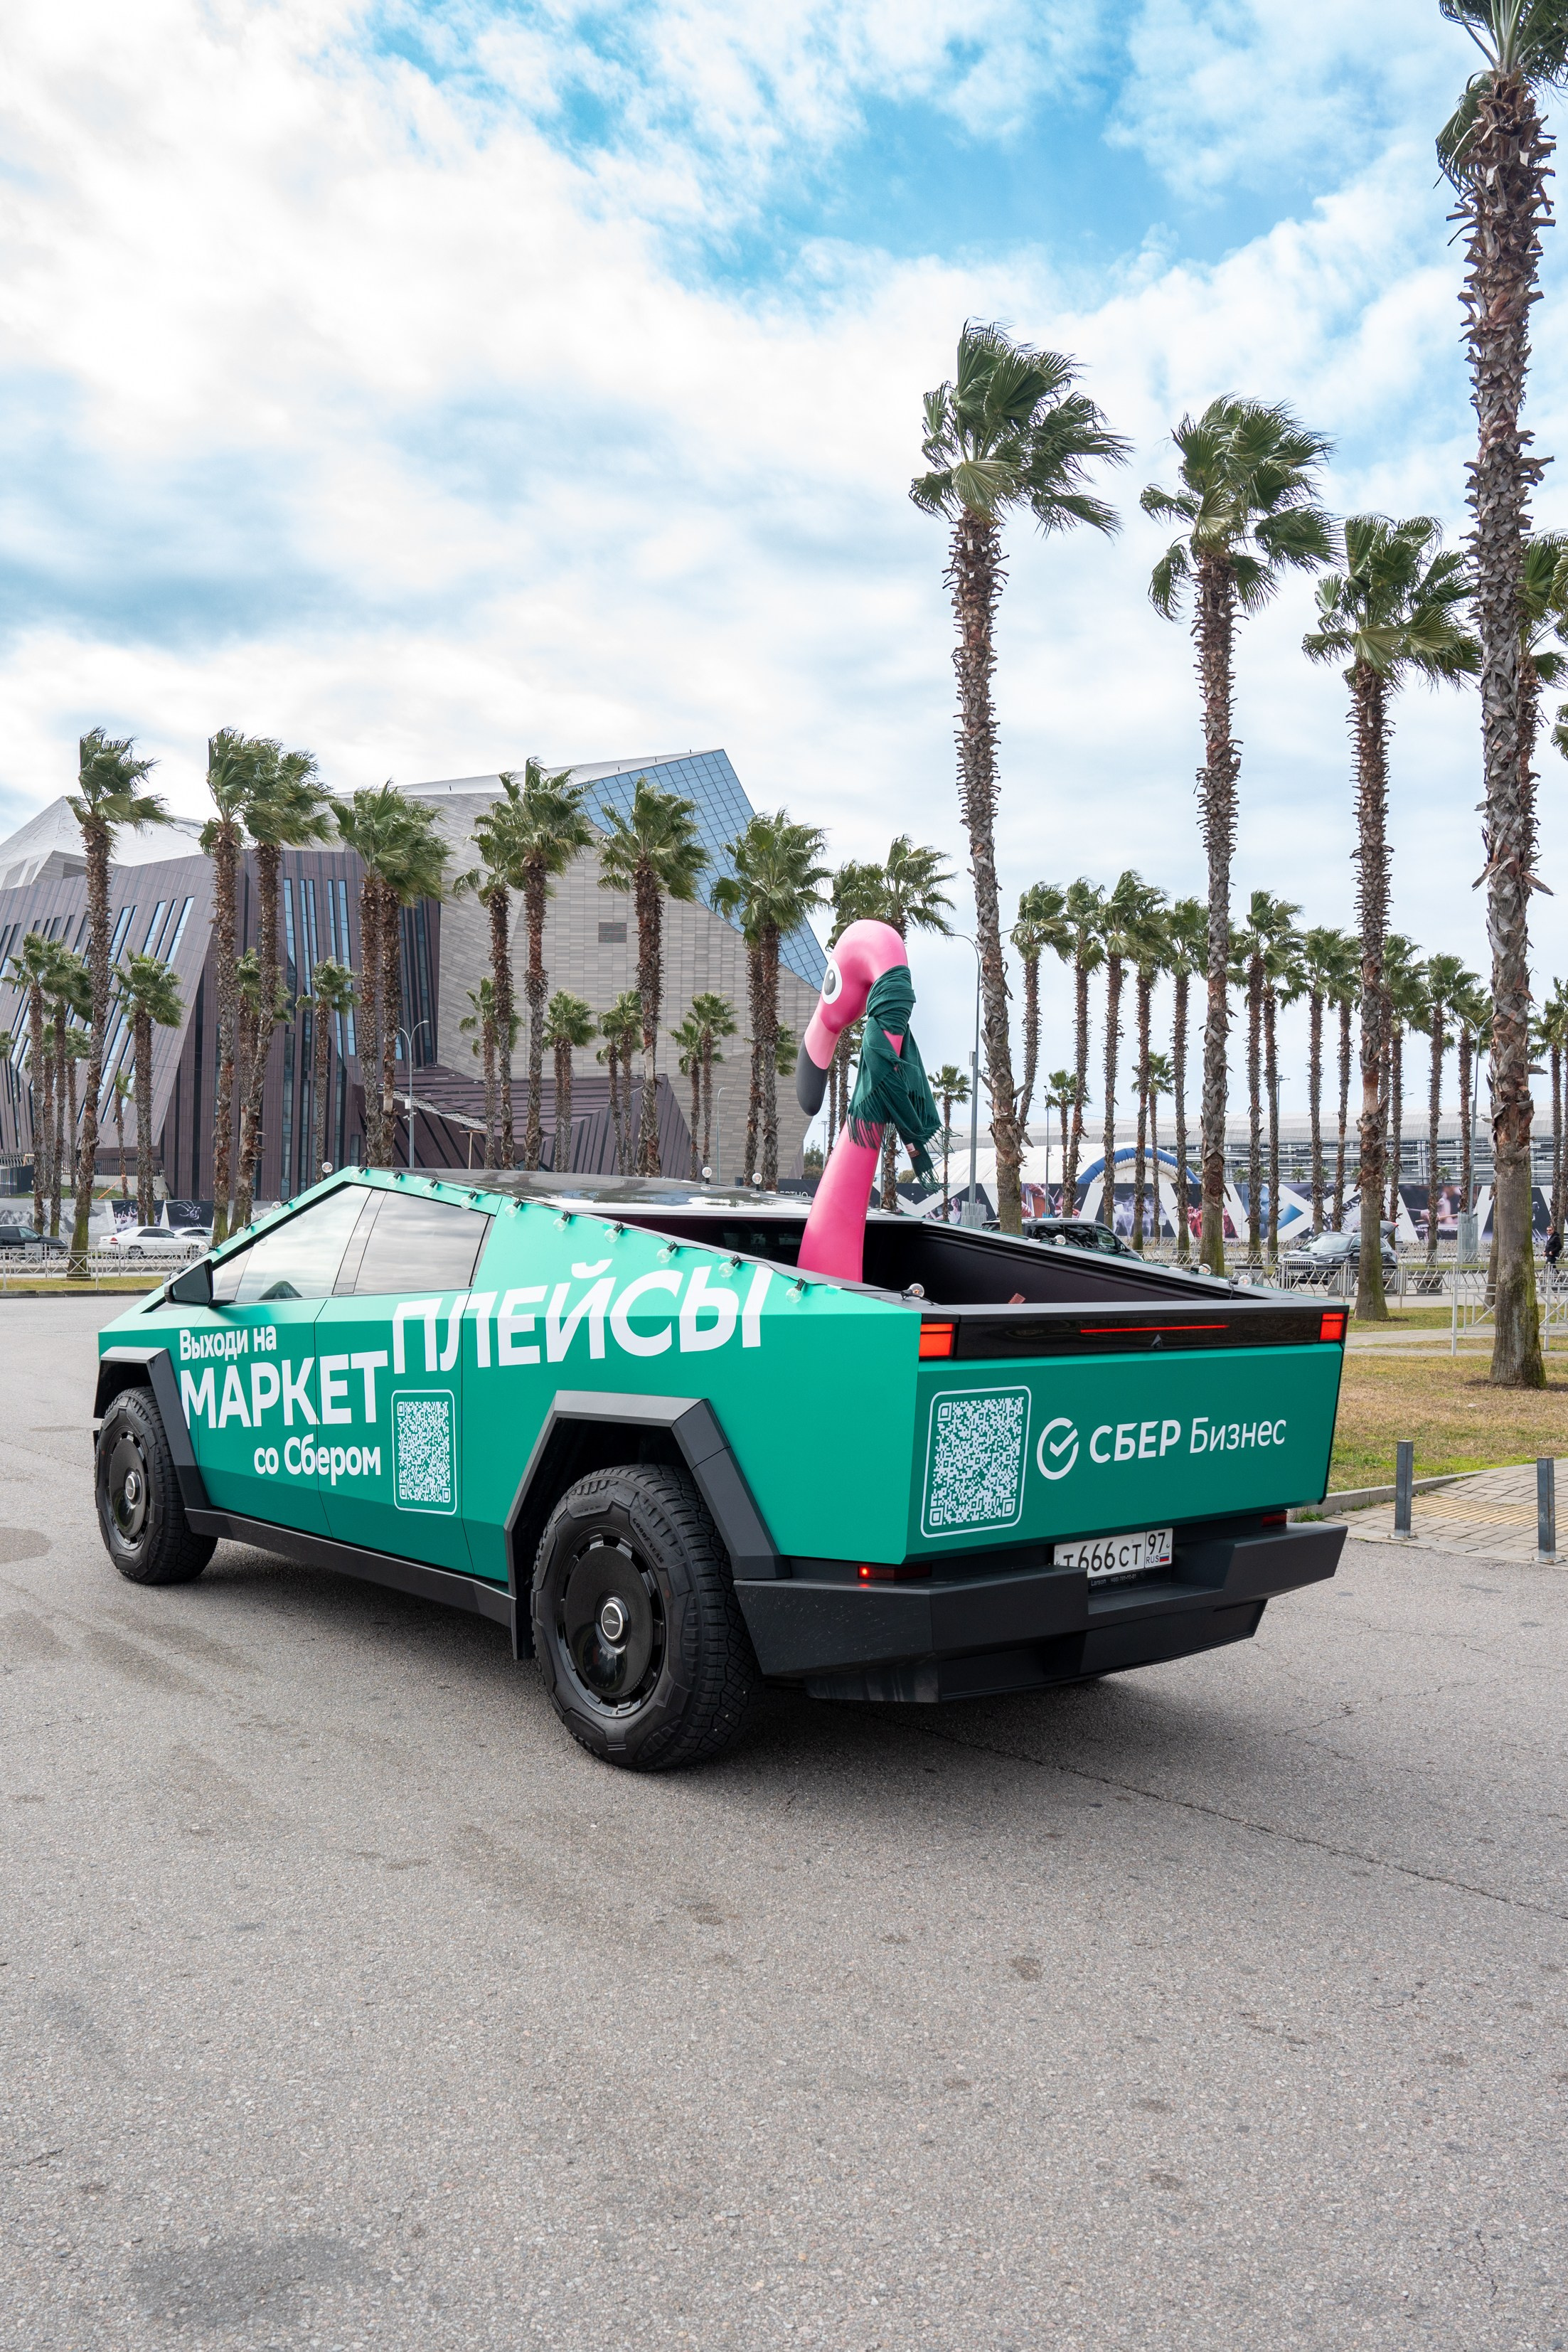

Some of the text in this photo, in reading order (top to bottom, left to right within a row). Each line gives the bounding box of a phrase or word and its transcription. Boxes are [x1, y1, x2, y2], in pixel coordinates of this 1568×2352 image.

[179, 1325, 277, 1361] Выходи на
[180, 1258, 774, 1430] МАРКЕТ ПЛЕЙСЫ
[254, 1434, 381, 1486] со Сбером
[1089, 1417, 1286, 1464] СБЕР Бизнес
[1146, 1555, 1159, 1565] RUS
[1148, 1531, 1166, 1555] 97
